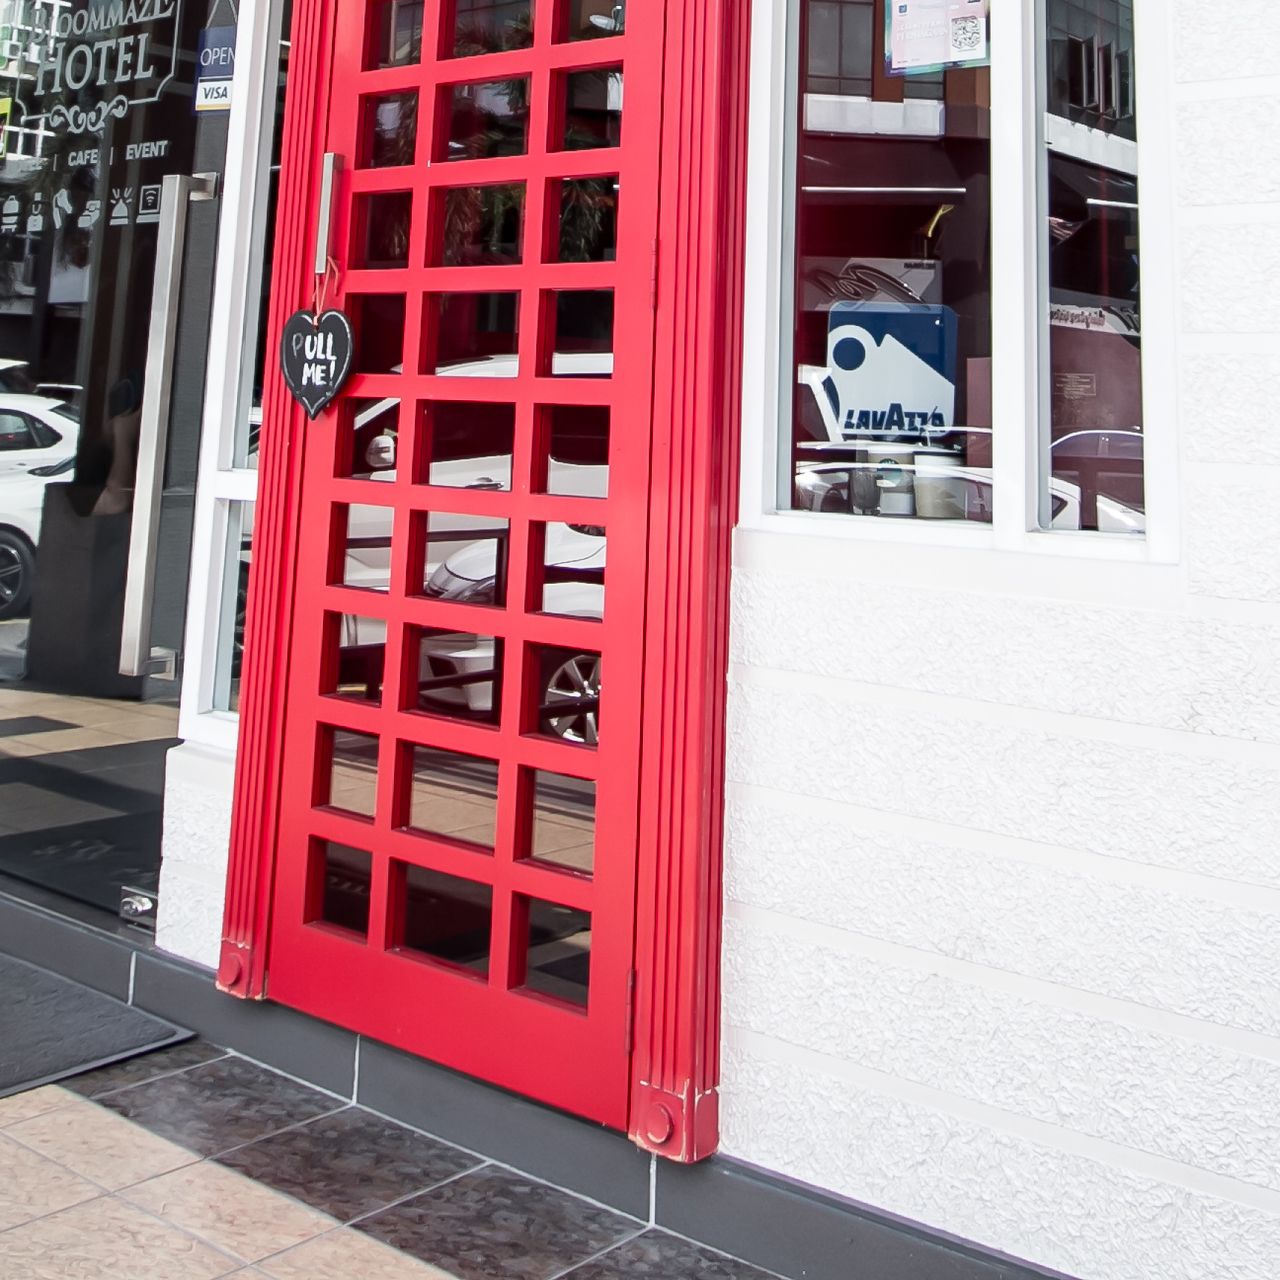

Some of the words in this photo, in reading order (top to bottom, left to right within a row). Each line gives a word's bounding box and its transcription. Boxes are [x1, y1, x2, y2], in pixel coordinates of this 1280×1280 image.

[33, 32, 154, 96] HOTEL
[200, 47, 235, 66] OPEN
[203, 86, 228, 100] VISA
[68, 149, 99, 167] CAFE
[126, 140, 169, 161] EVENT
[292, 332, 337, 360] PULL
[302, 360, 336, 386] ME!
[844, 403, 945, 432] LAVAZZA
